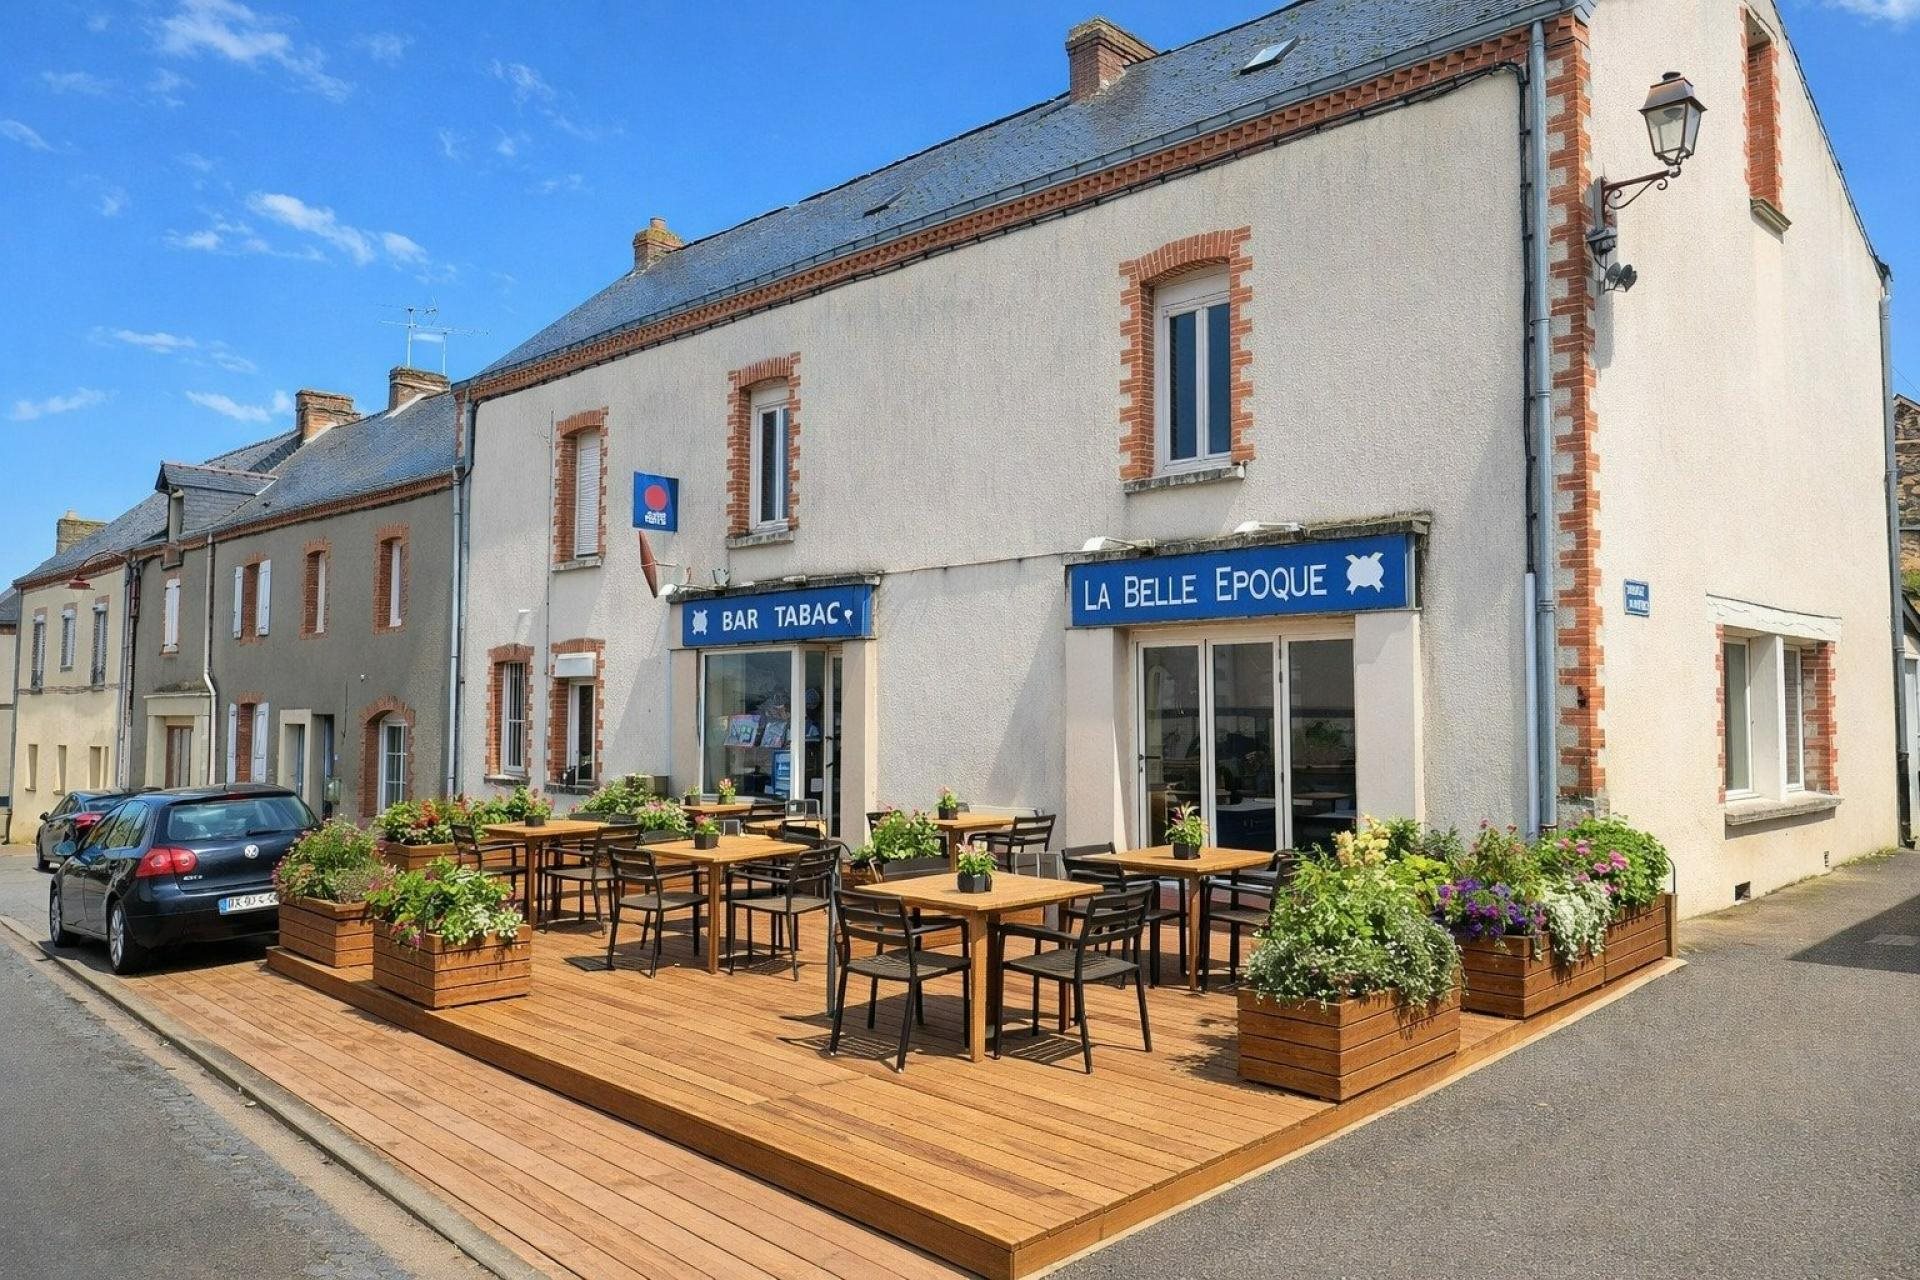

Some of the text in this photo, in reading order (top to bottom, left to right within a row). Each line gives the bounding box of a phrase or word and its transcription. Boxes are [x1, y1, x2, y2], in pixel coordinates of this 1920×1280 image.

[1084, 564, 1327, 611] LA BELLE EPOQUE
[722, 601, 840, 631] BAR TABAC
